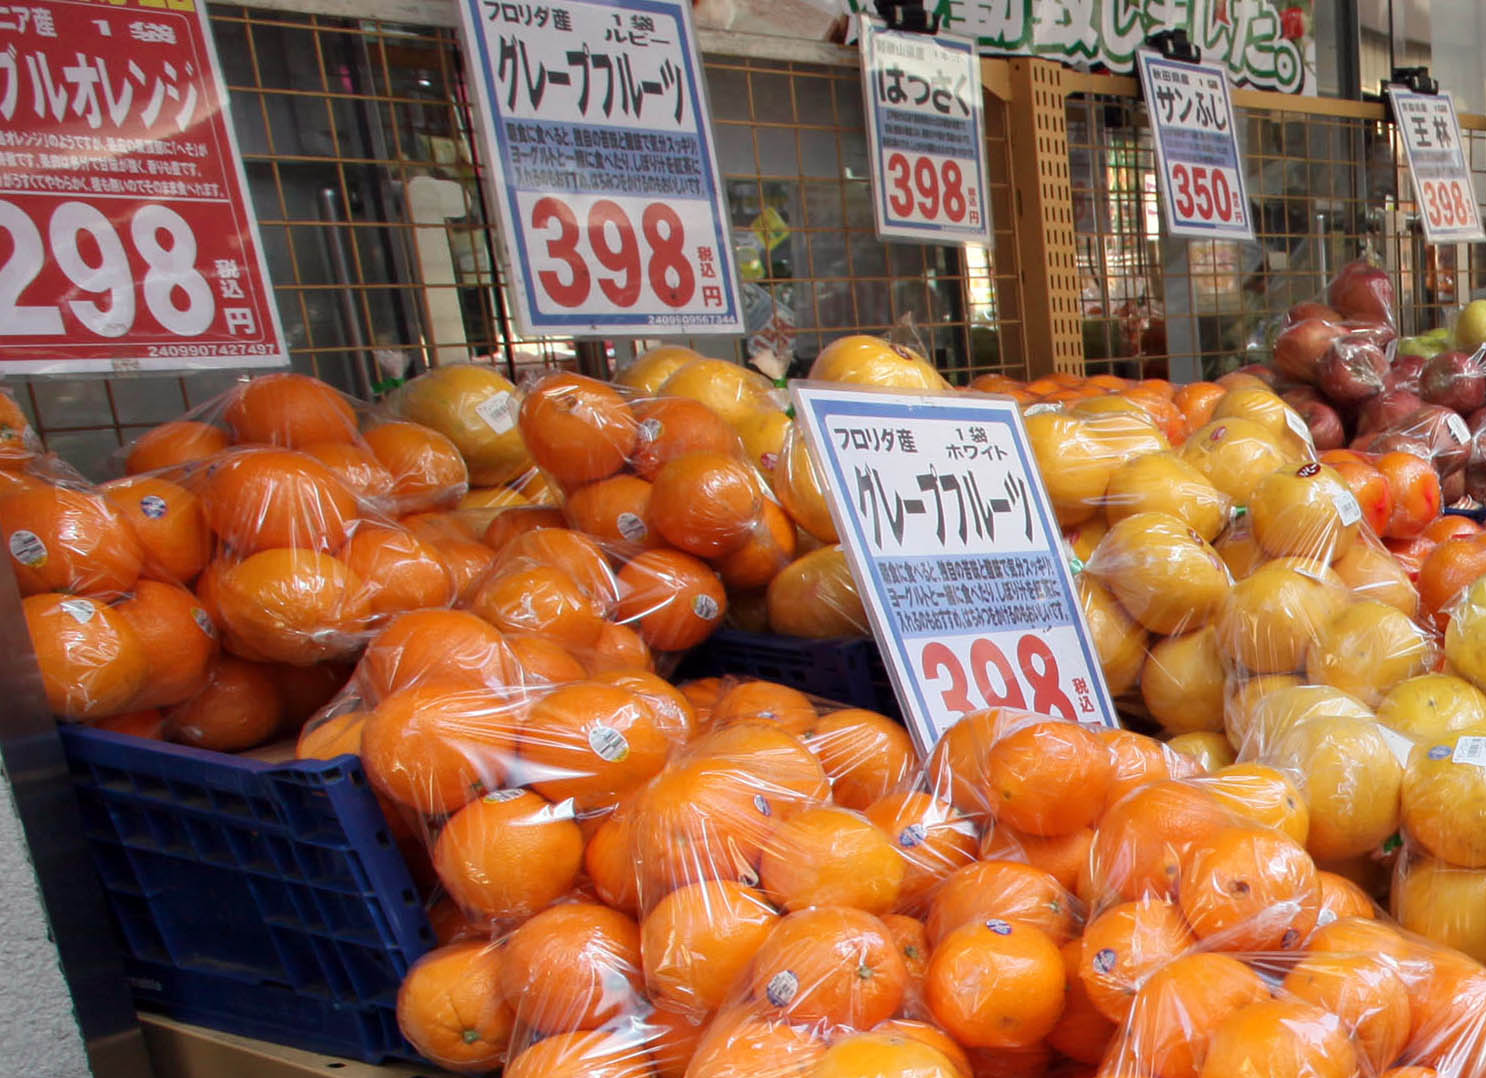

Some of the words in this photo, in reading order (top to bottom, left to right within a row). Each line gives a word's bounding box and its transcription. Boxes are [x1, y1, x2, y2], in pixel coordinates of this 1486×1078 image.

[483, 1, 573, 32] フロリダ産
[604, 28, 671, 47] ルビー
[498, 33, 684, 124] グレープフルーツ
[1155, 84, 1227, 131] サンふじ
[1410, 115, 1452, 149] 王林
[888, 152, 967, 223] 398
[1171, 162, 1233, 223] 350
[1423, 180, 1468, 227] 398
[0, 200, 216, 338] 298
[531, 196, 696, 308] 398
[701, 285, 723, 308] 円
[223, 307, 257, 335] 円
[148, 343, 275, 358] 2409907427497
[833, 427, 919, 454] フロリダ産
[945, 443, 1009, 462] ホワイト
[854, 461, 1034, 551] グレープフルーツ
[1071, 676, 1095, 713] 税込
